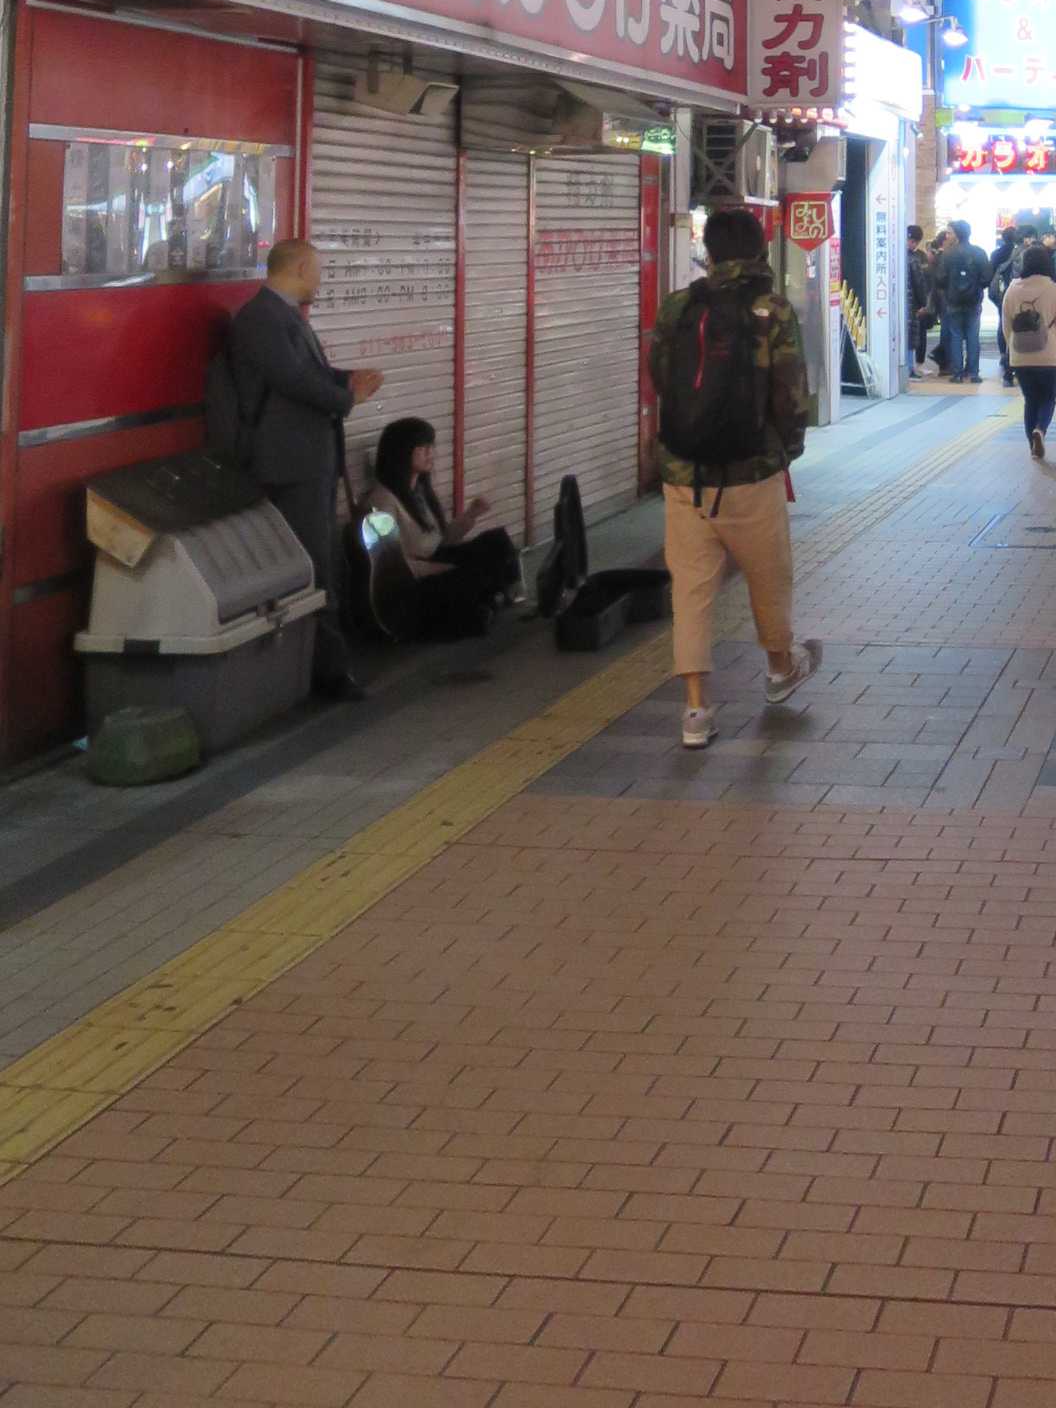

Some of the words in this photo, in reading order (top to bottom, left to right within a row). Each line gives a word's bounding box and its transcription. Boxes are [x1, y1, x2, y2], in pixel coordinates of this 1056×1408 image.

[875, 211, 889, 301] 無料案内所入口
